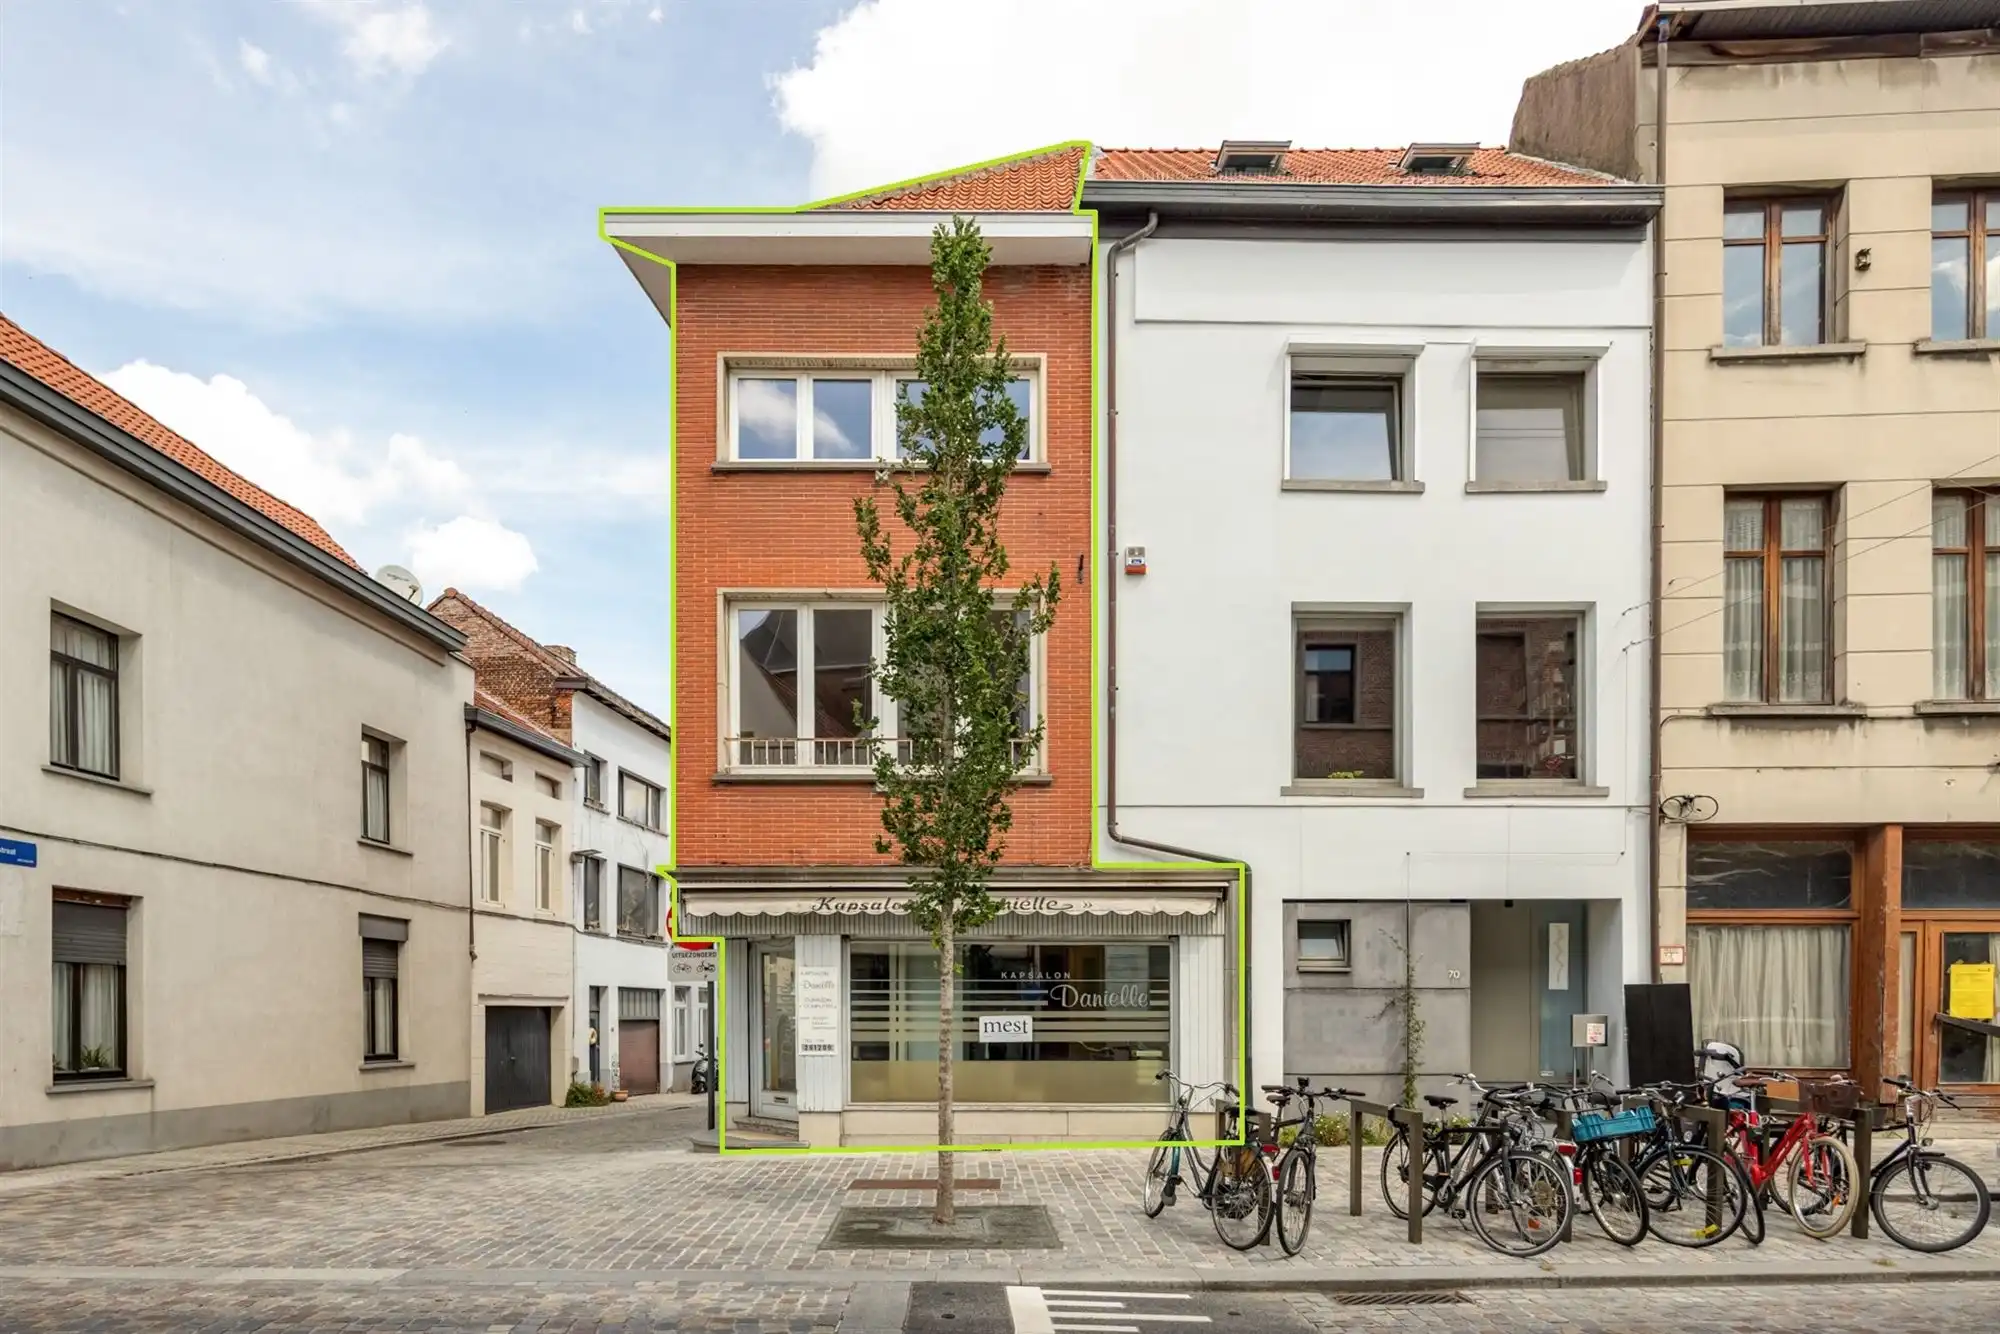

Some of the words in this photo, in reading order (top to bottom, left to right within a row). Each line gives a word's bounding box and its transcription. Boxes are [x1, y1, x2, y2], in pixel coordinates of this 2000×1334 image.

[812, 896, 907, 912] Kapsalo
[1001, 971, 1071, 979] KAPSALON
[1447, 969, 1461, 979] 70
[1050, 984, 1148, 1008] Danielle
[984, 1020, 1029, 1034] mest
